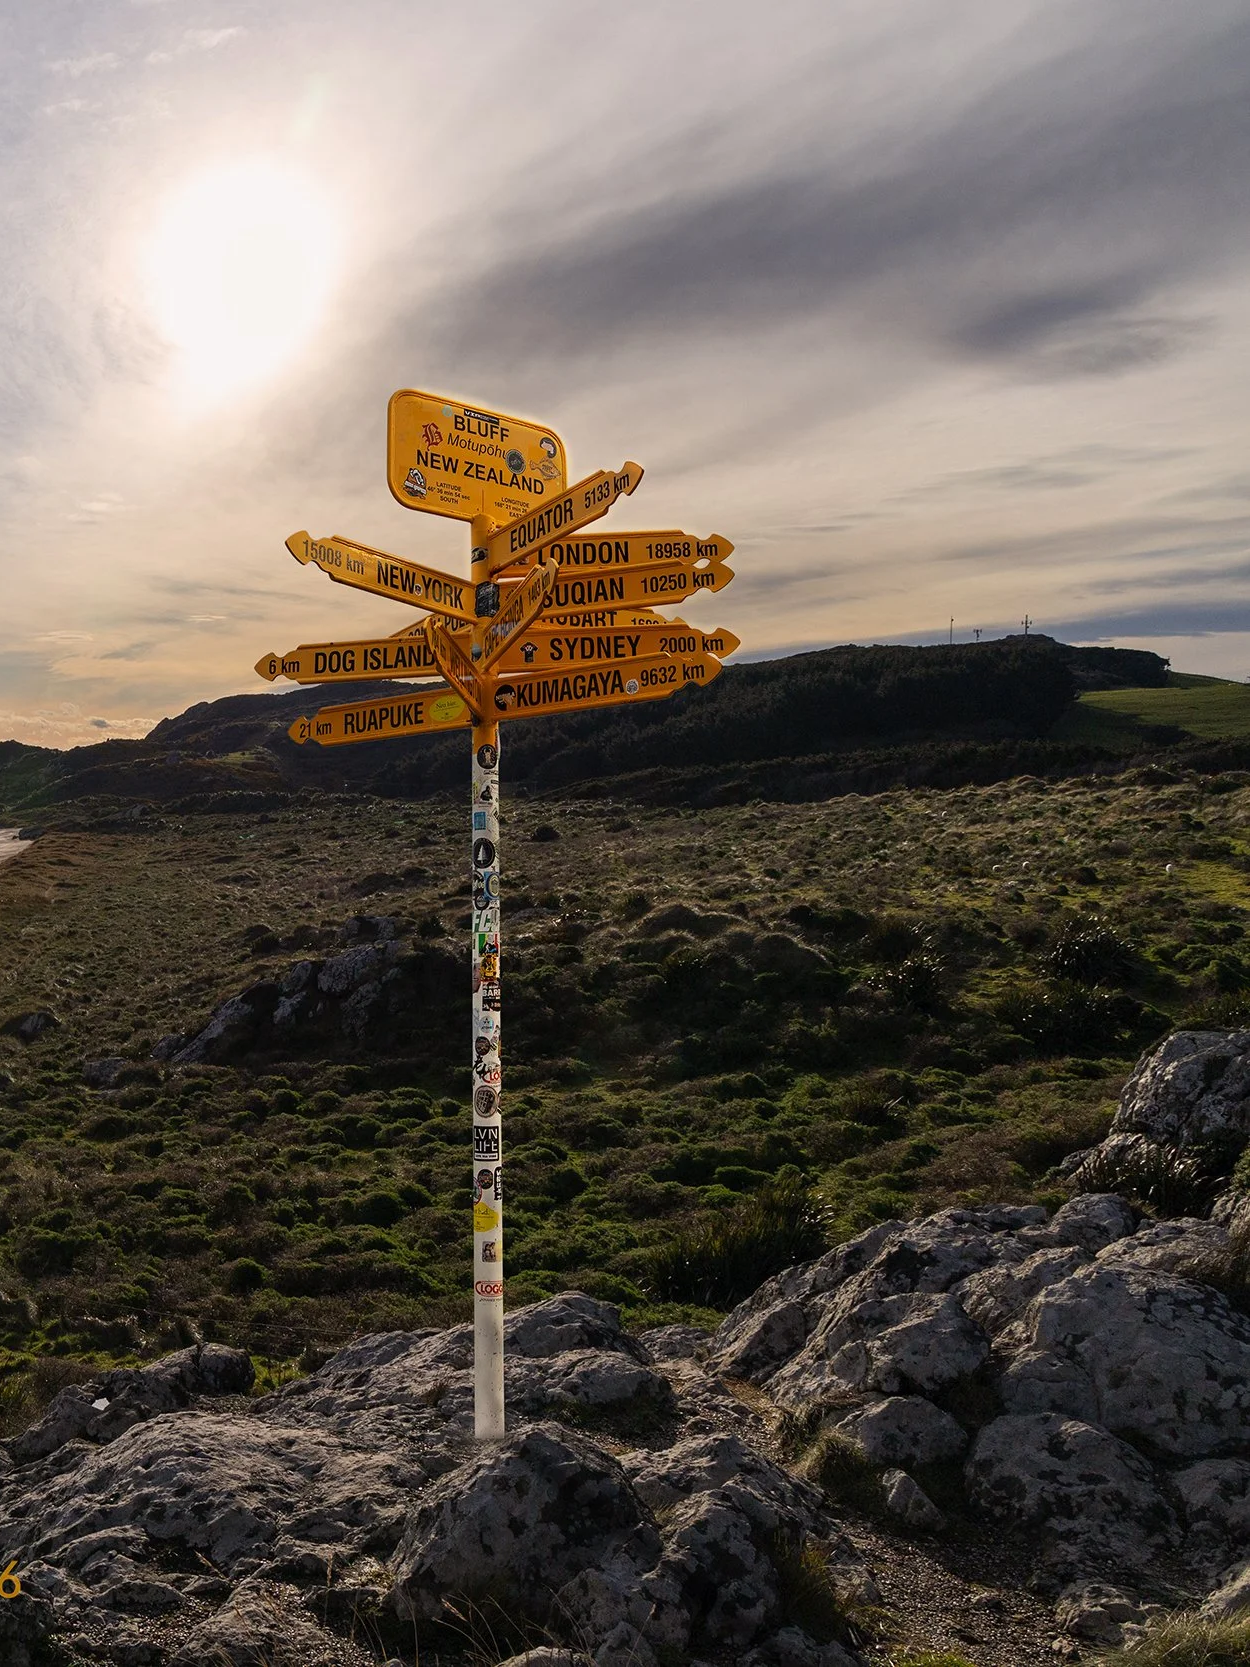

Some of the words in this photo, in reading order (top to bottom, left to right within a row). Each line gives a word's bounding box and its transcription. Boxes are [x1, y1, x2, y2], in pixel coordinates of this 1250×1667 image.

[454, 414, 510, 442] BLUFF
[416, 449, 459, 474] NEW
[463, 460, 544, 495] ZEALAND
[436, 481, 462, 492] LATITUDE
[440, 495, 459, 504] SOUTH
[501, 496, 530, 508] LONGITUDE
[510, 498, 574, 553] EQUATOR
[584, 481, 610, 509] 5133
[613, 473, 630, 494] km
[537, 540, 629, 567] LONDON
[645, 542, 691, 560] 18958
[696, 540, 718, 558] km
[302, 539, 342, 568] 15008
[346, 553, 365, 576] km
[377, 560, 416, 595] NEW
[421, 575, 464, 611] YORK
[543, 576, 625, 609] SUQIAN
[640, 573, 687, 594] 10250
[692, 571, 715, 588] km
[269, 659, 277, 675] 6
[281, 658, 300, 674] km
[314, 649, 355, 675] DOG
[363, 644, 436, 671] ISLAND
[549, 634, 641, 661] SYDNEY
[659, 635, 696, 654] 2000
[702, 635, 724, 652] km
[516, 669, 625, 708] KUMAGAYA
[640, 664, 677, 688] 9632
[682, 663, 705, 682] km
[300, 722, 312, 739] 21
[316, 720, 332, 736] km
[344, 701, 424, 735] RUAPUKE
[474, 1140, 498, 1152] LIFE
